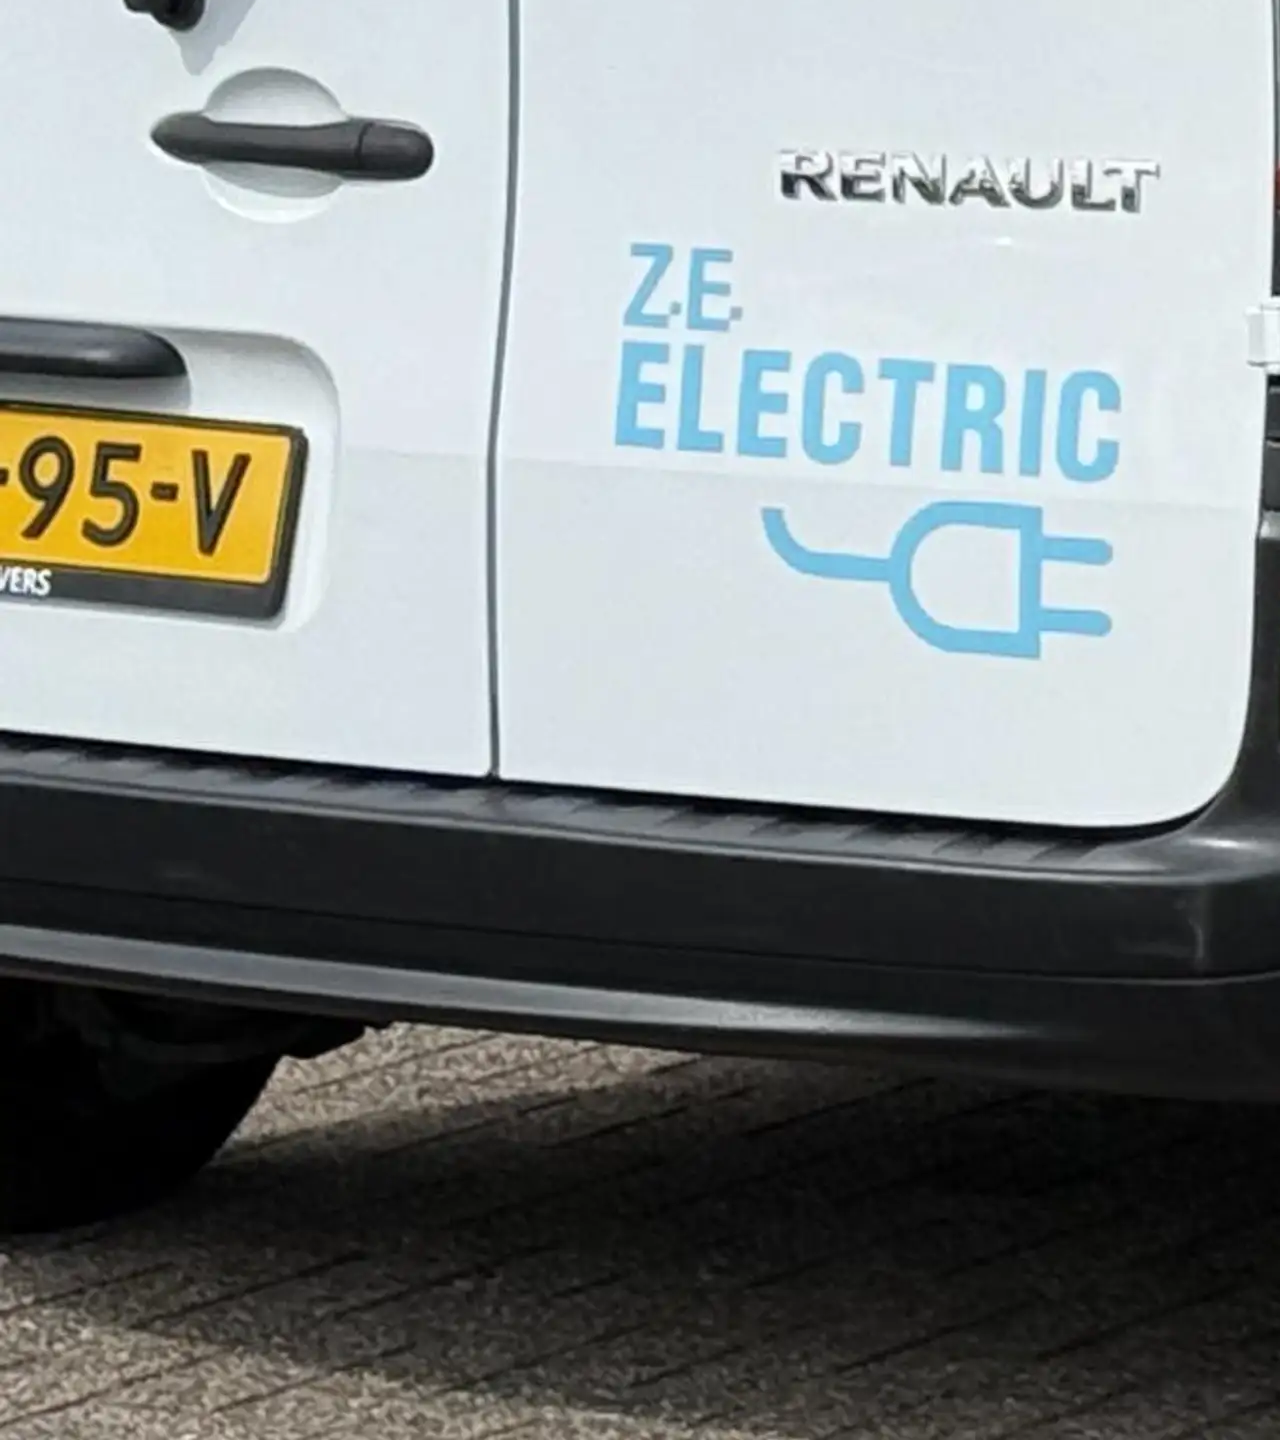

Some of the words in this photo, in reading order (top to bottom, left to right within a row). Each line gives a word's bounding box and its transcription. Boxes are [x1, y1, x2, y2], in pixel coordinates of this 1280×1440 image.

[778, 148, 1161, 214] RENAULT
[622, 242, 743, 332] Z.E.
[614, 339, 1122, 484] ELECTRIC
